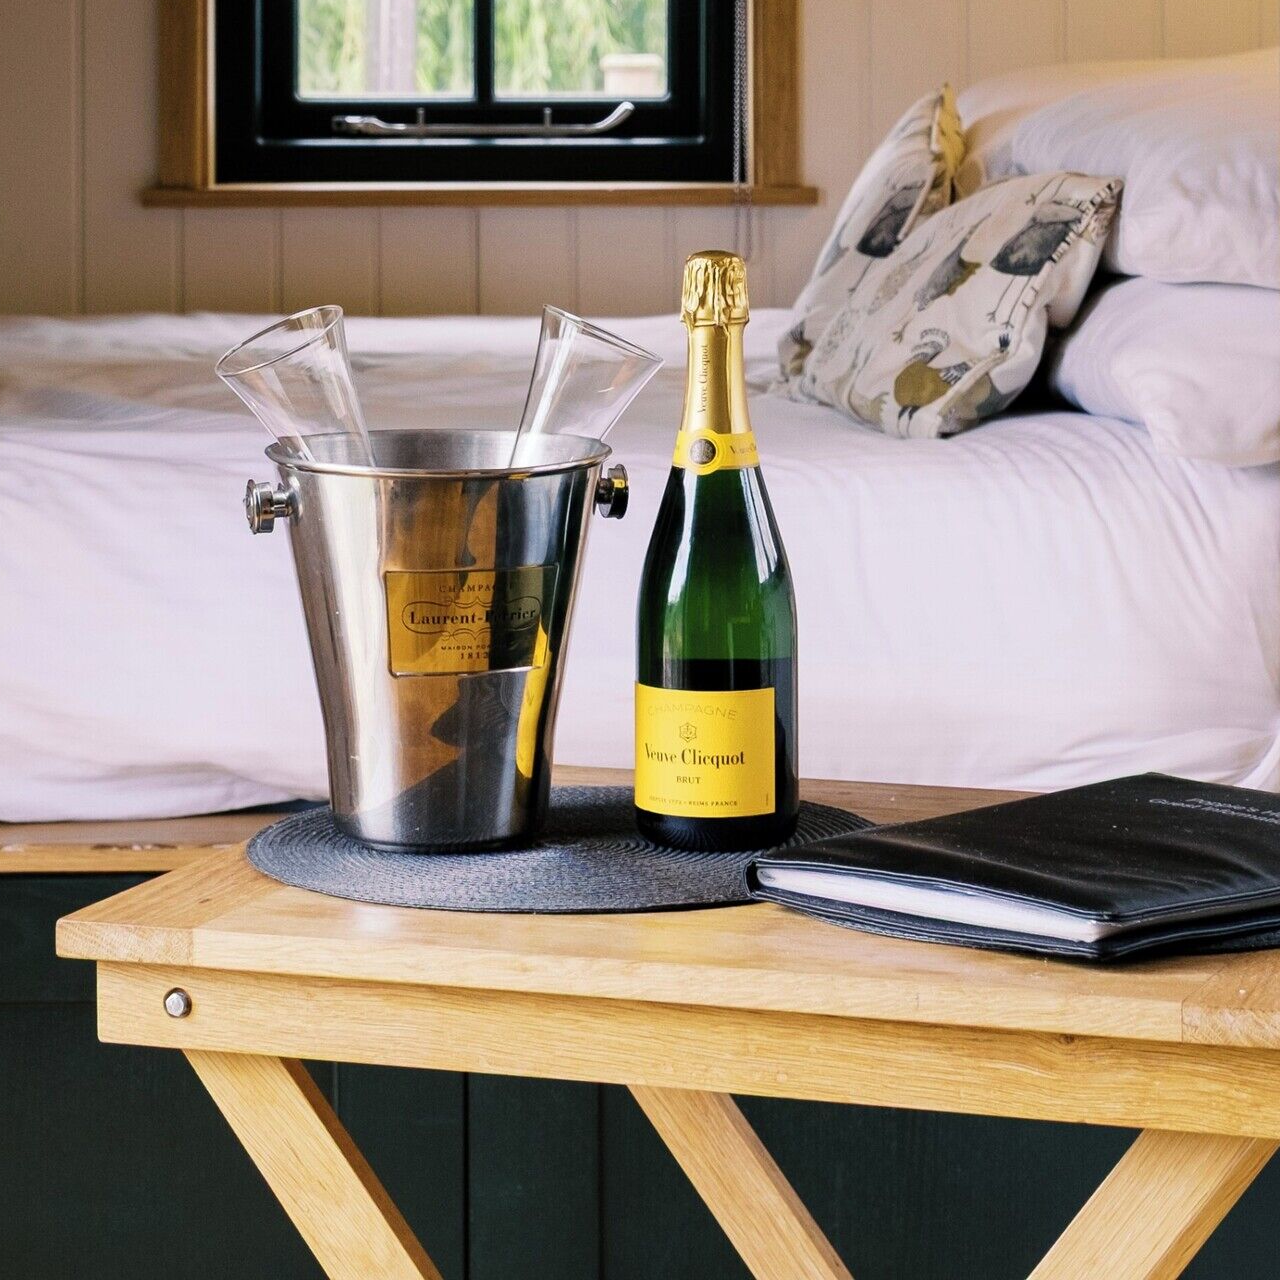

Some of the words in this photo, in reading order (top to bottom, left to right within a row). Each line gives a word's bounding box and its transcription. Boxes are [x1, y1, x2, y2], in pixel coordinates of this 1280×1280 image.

[647, 703, 738, 721] CHAMPAGNE
[644, 742, 678, 763] Veuve
[681, 748, 746, 769] Clicquot
[676, 776, 702, 785] BRUT
